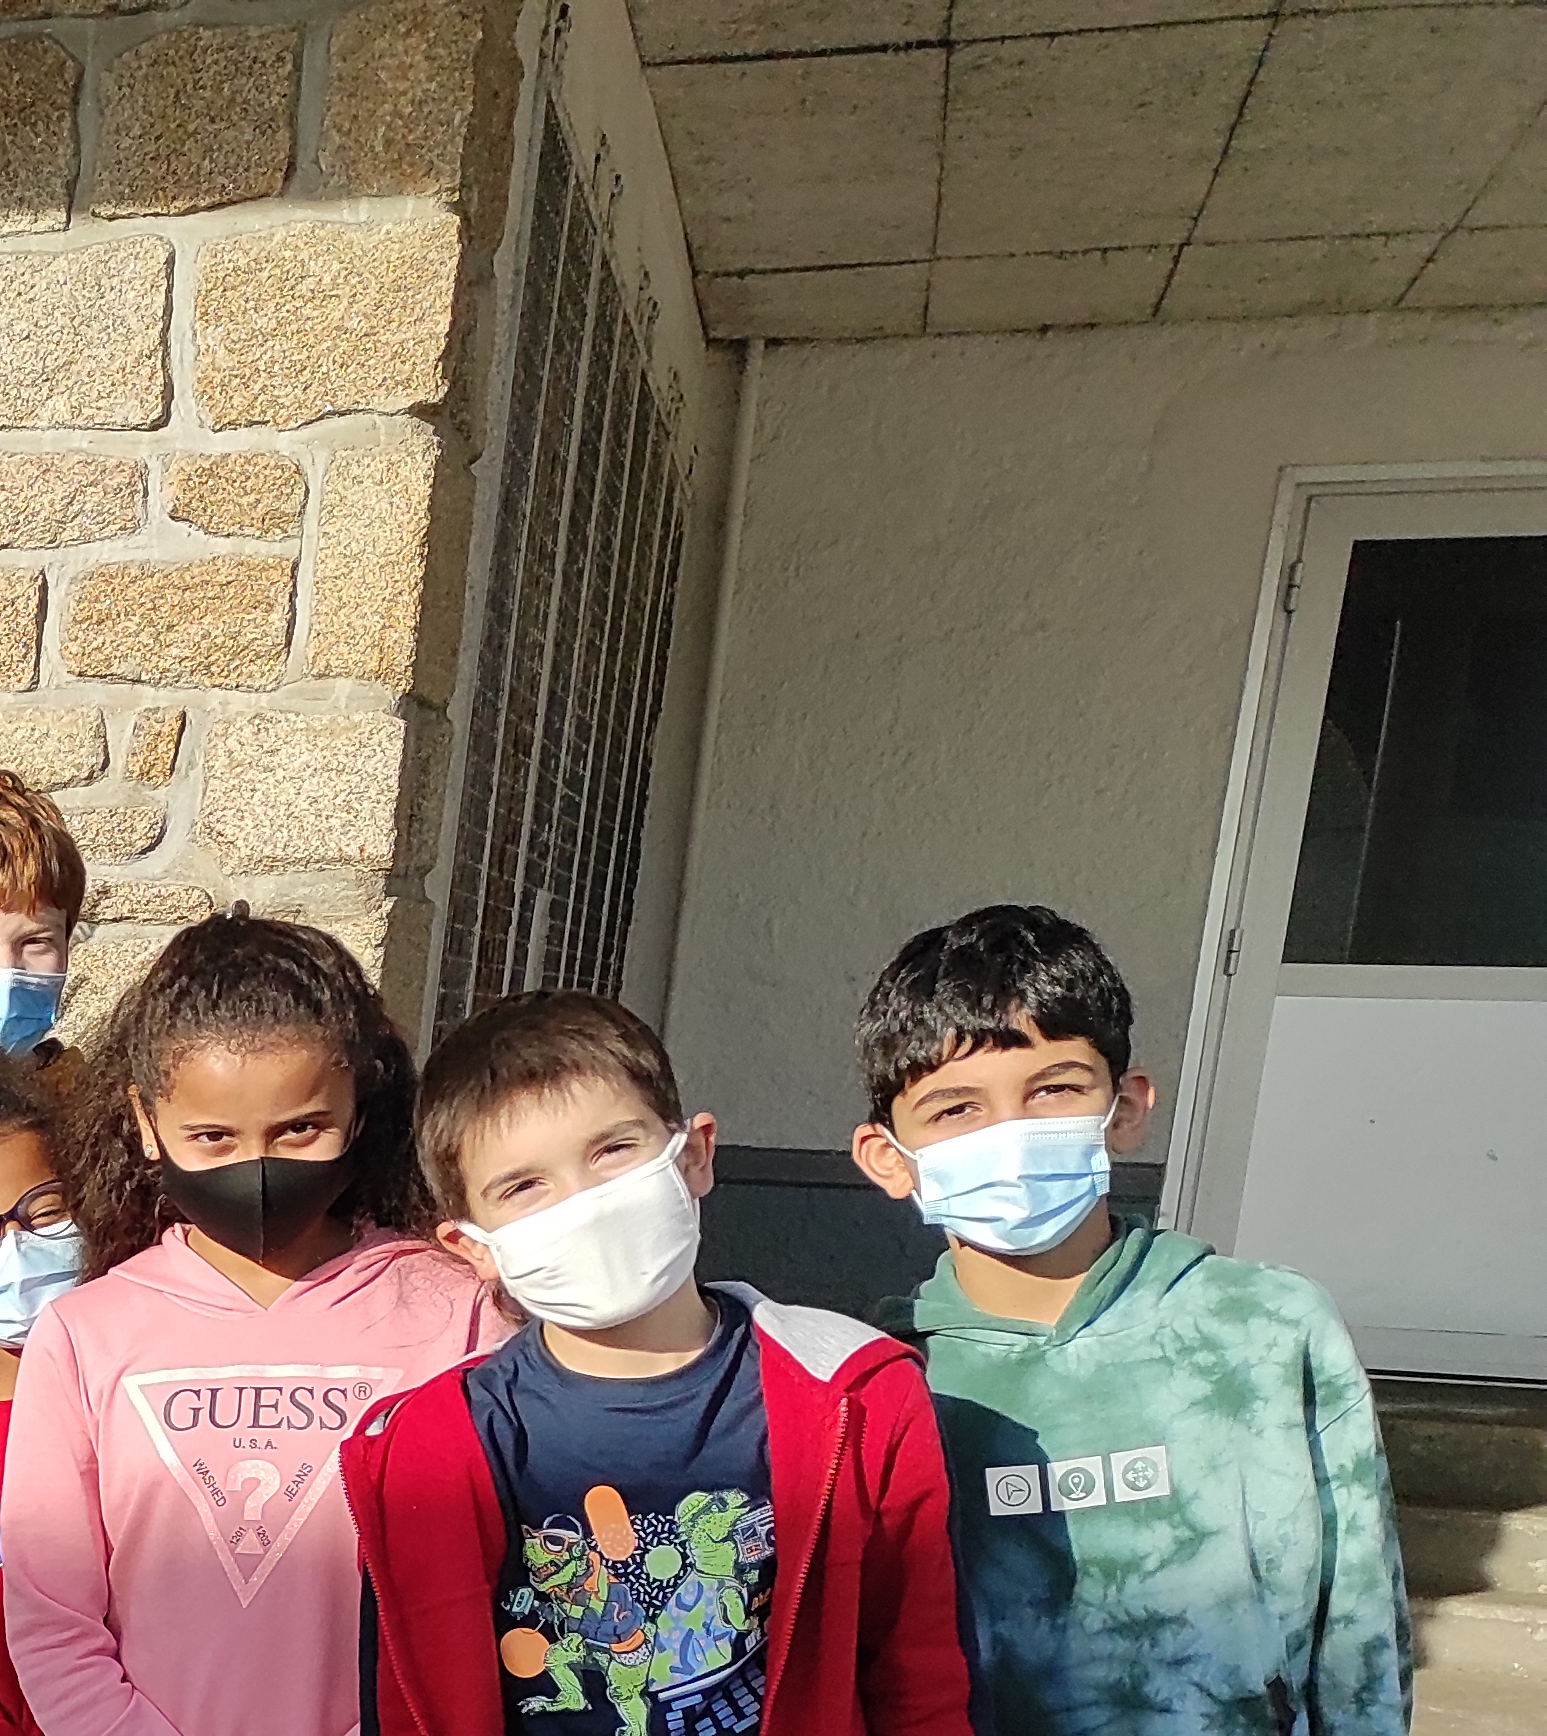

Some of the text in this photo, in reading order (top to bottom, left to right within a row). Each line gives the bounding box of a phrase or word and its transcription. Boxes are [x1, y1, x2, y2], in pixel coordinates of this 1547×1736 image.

[163, 1386, 349, 1431] GUESS
[192, 1458, 227, 1507] WASHED
[283, 1462, 314, 1502] JEANS
